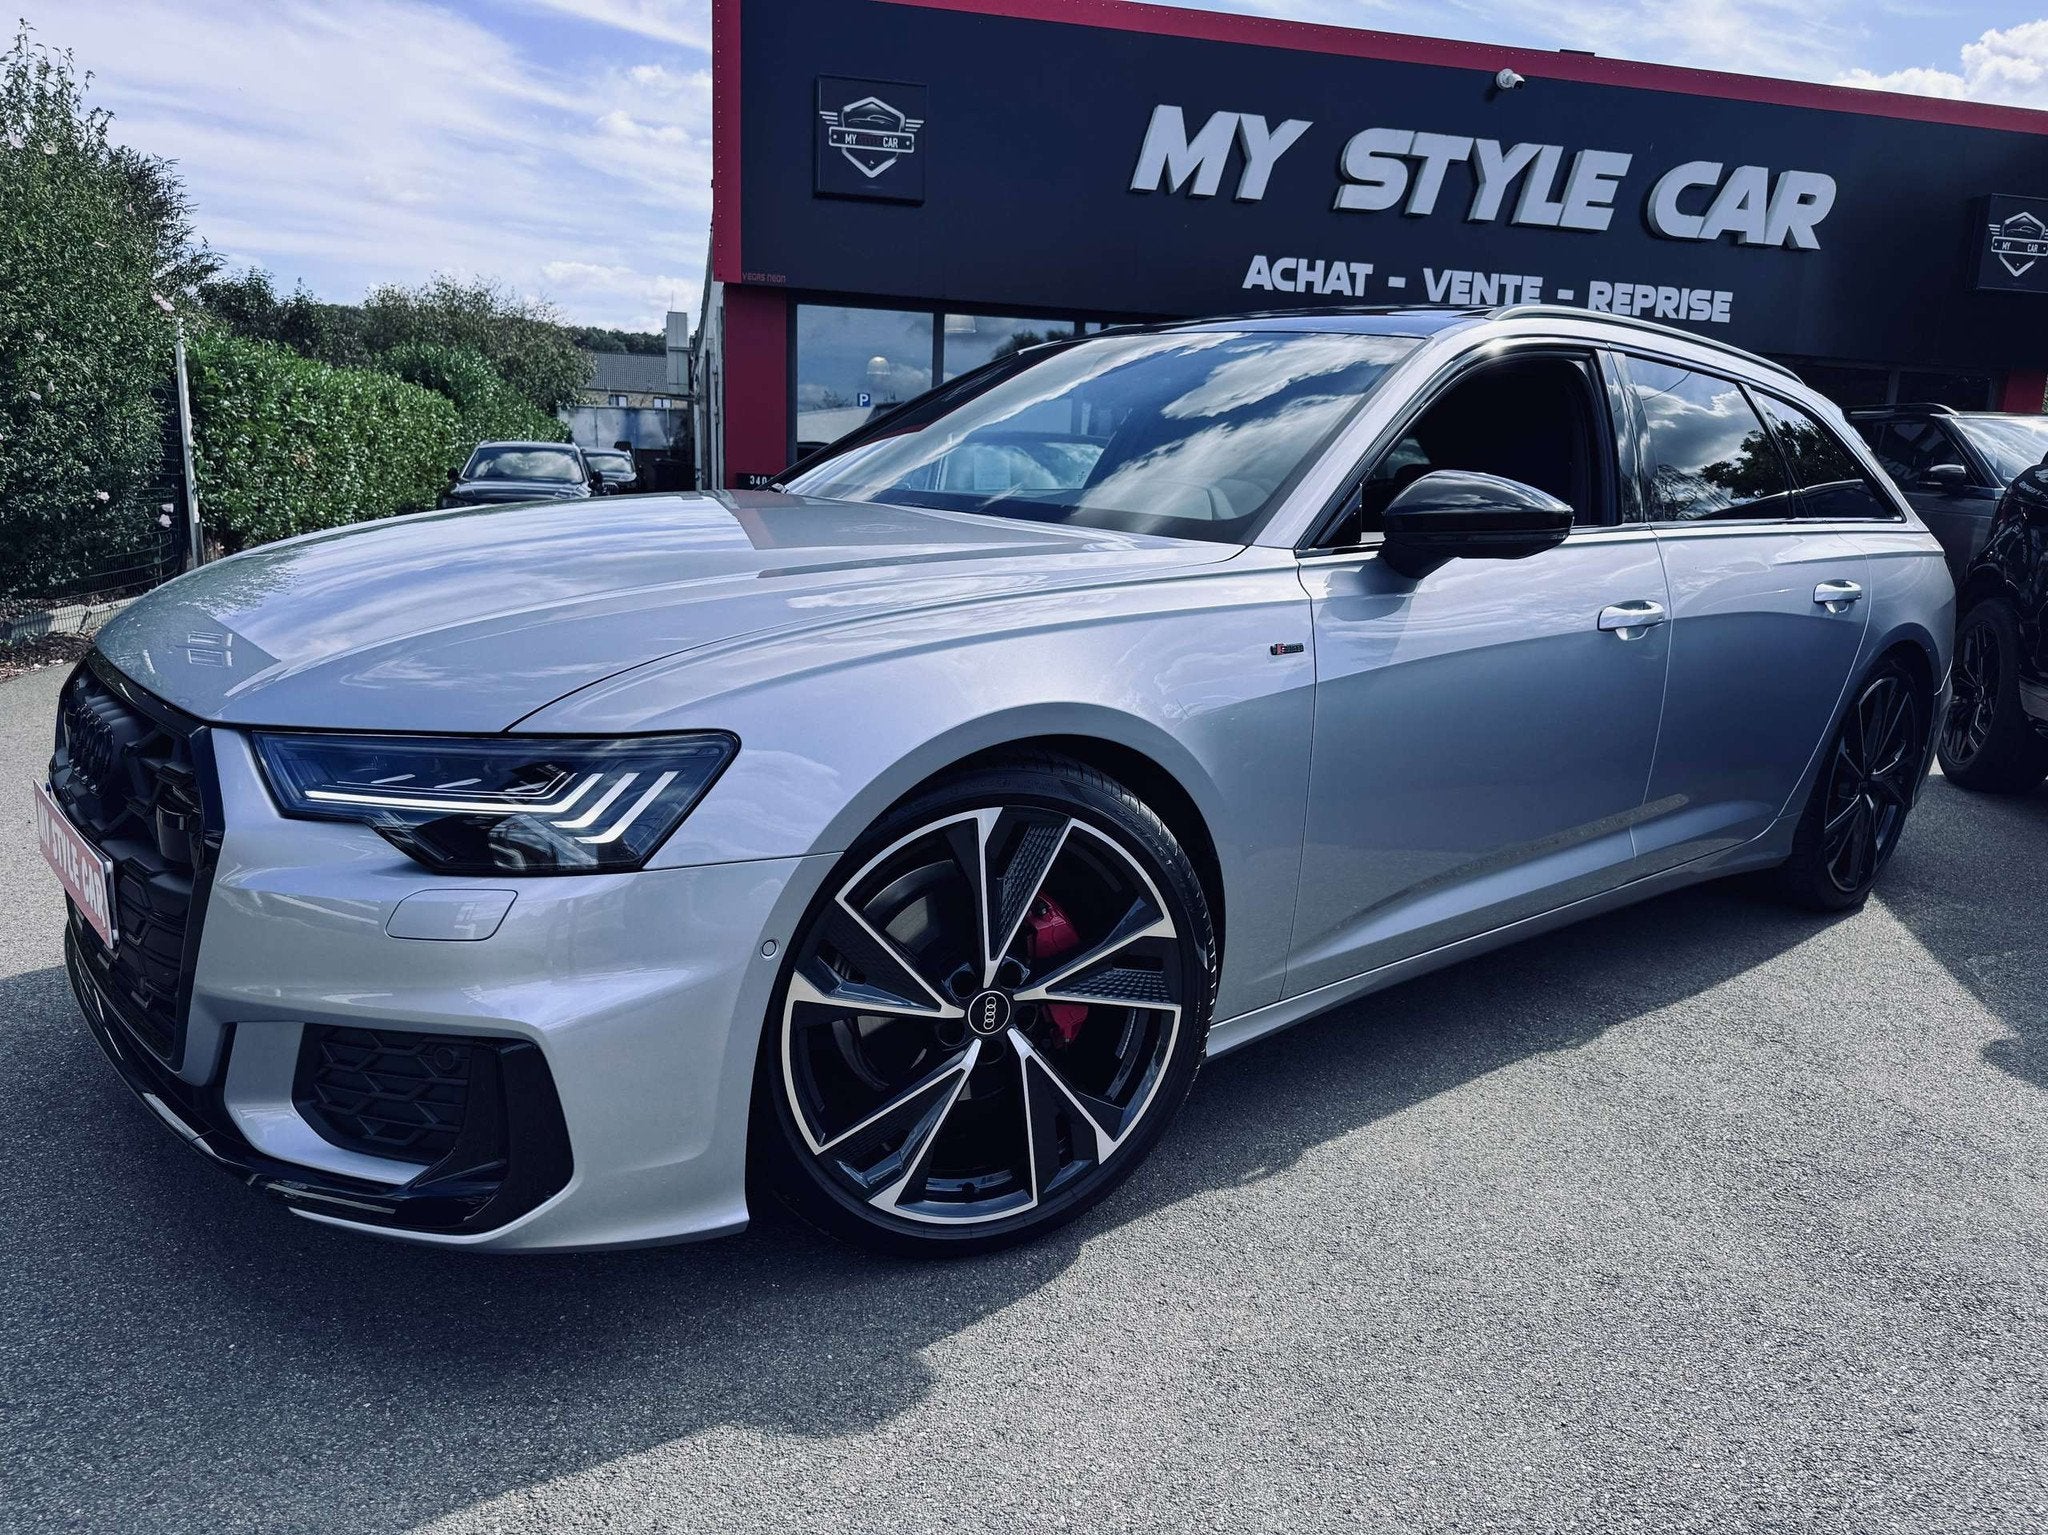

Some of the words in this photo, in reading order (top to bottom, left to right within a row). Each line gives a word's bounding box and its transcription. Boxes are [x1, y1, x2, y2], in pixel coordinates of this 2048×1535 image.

[845, 133, 857, 144] MY
[882, 136, 898, 148] CAR
[1130, 104, 1314, 201] MY
[1333, 127, 1633, 231] STYLE
[1647, 160, 1837, 251] CAR
[2002, 242, 2011, 250] MY
[2027, 244, 2038, 253] CAR
[1242, 255, 1374, 297] ACHAT
[1423, 267, 1543, 305] VENTE
[1587, 280, 1734, 323] REPRISE
[859, 393, 869, 406] P
[749, 475, 773, 485] 340
[51, 816, 80, 891] STYLE
[81, 856, 106, 929] CAR
